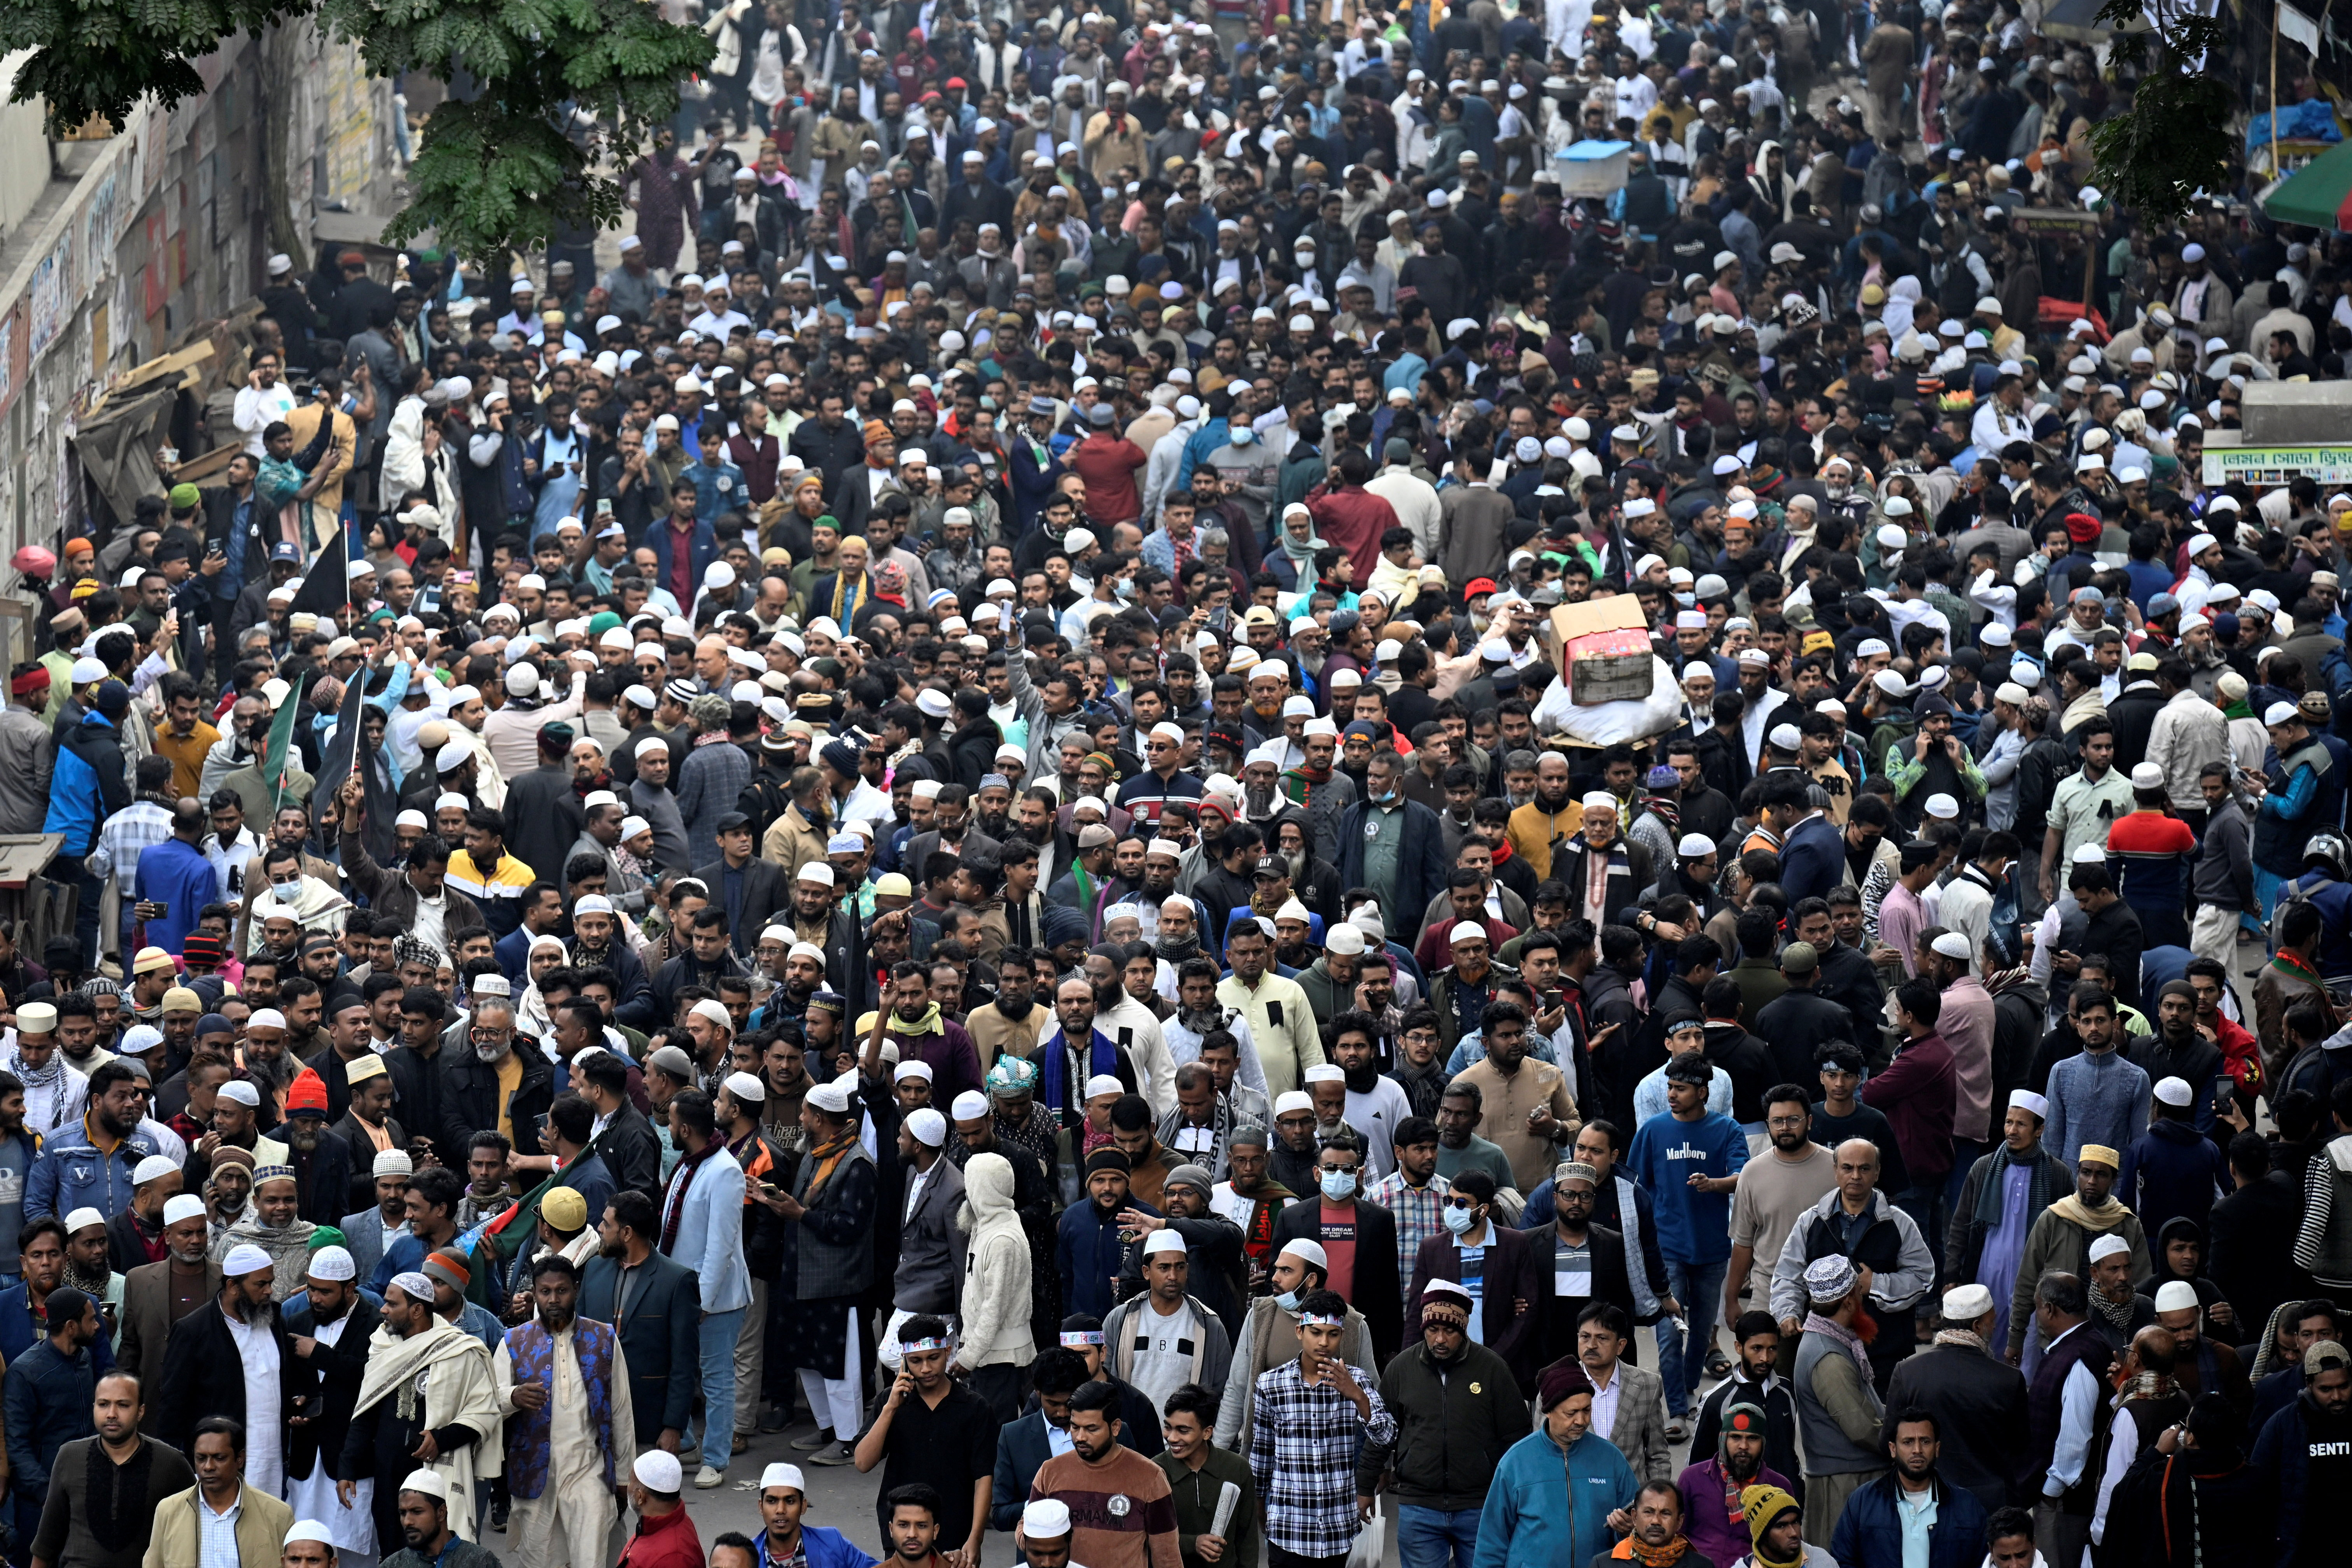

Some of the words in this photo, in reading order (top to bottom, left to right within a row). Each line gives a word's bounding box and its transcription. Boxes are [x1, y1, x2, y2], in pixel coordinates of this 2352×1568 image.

[2223, 453, 2265, 466] লেমন
[2273, 453, 2312, 465] সোডা
[1259, 858, 1272, 867] GAP
[1666, 1142, 1706, 1160] Marlboro
[73, 1167, 88, 1180] V
[1304, 1314, 1319, 1323] ছাত্র
[913, 1339, 932, 1349] দল
[1159, 1339, 1166, 1351] B
[2309, 1442, 2350, 1457] SENTI
